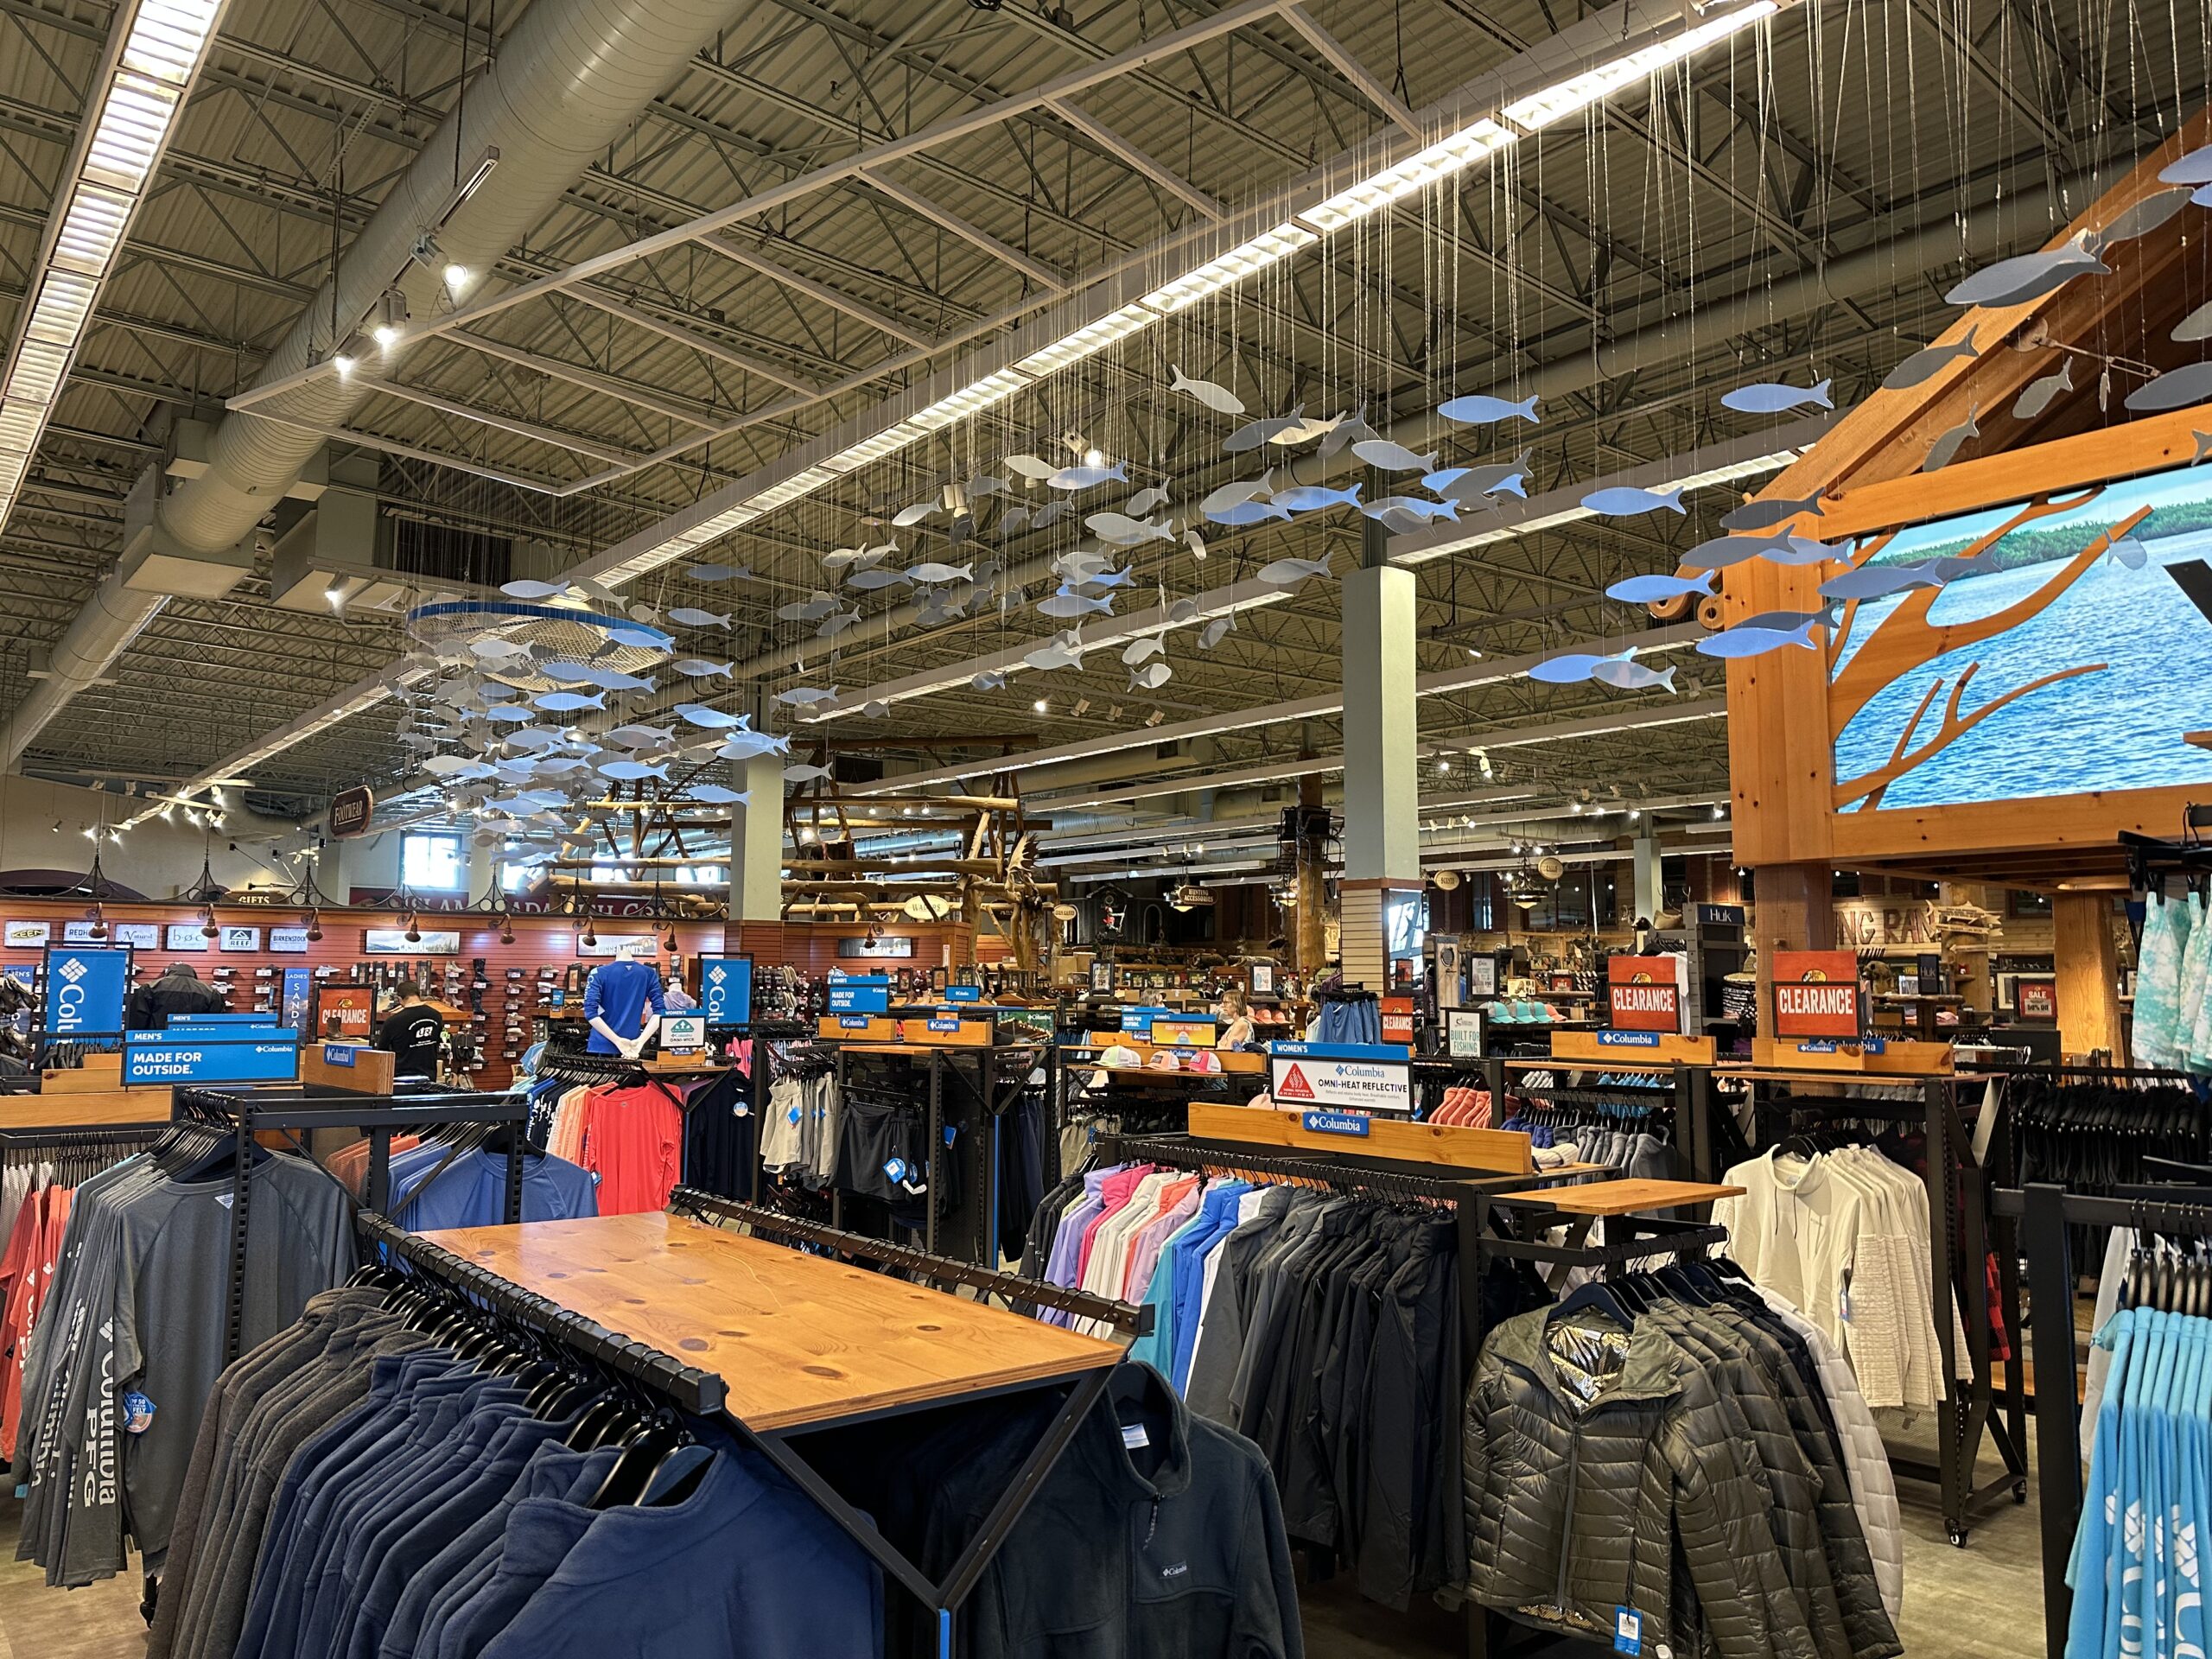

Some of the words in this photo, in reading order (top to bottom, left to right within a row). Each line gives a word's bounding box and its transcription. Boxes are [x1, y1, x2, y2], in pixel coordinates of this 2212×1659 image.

[334, 799, 363, 826] FOOTWEAR
[238, 895, 270, 904] GIFTS
[912, 903, 941, 912] WADRS
[1709, 908, 1732, 923] Huk
[12, 929, 44, 939] KEEN
[124, 931, 153, 941] Natural
[1920, 967, 1936, 976] Huk
[1612, 988, 1674, 1012] CLEARANCE
[1779, 988, 1853, 1014] CLEARANCE
[321, 1008, 367, 1025] CLEARANCE
[846, 1018, 865, 1027] Columbia
[935, 1021, 956, 1031] Columbia
[1382, 1015, 1413, 1031] CLEARANCE
[1451, 1029, 1467, 1040] BUILT
[1469, 1030, 1480, 1041] FOR
[1612, 1033, 1652, 1045] Columbia
[263, 1045, 293, 1053] Columbia
[1276, 1043, 1308, 1053] WOMEN'S
[1453, 1040, 1478, 1053] FISHING
[133, 1052, 172, 1064] MADE
[175, 1052, 202, 1063] FOR
[330, 1049, 351, 1064] Columbia
[132, 1064, 194, 1076] OUTSIDE.
[1344, 1065, 1385, 1078] Columbia
[1318, 1078, 1360, 1090] OMNI-HEAT
[1362, 1082, 1408, 1093] REFLECTIVE
[1319, 1116, 1361, 1132] Columbia
[84, 1408, 99, 1508] PFG
